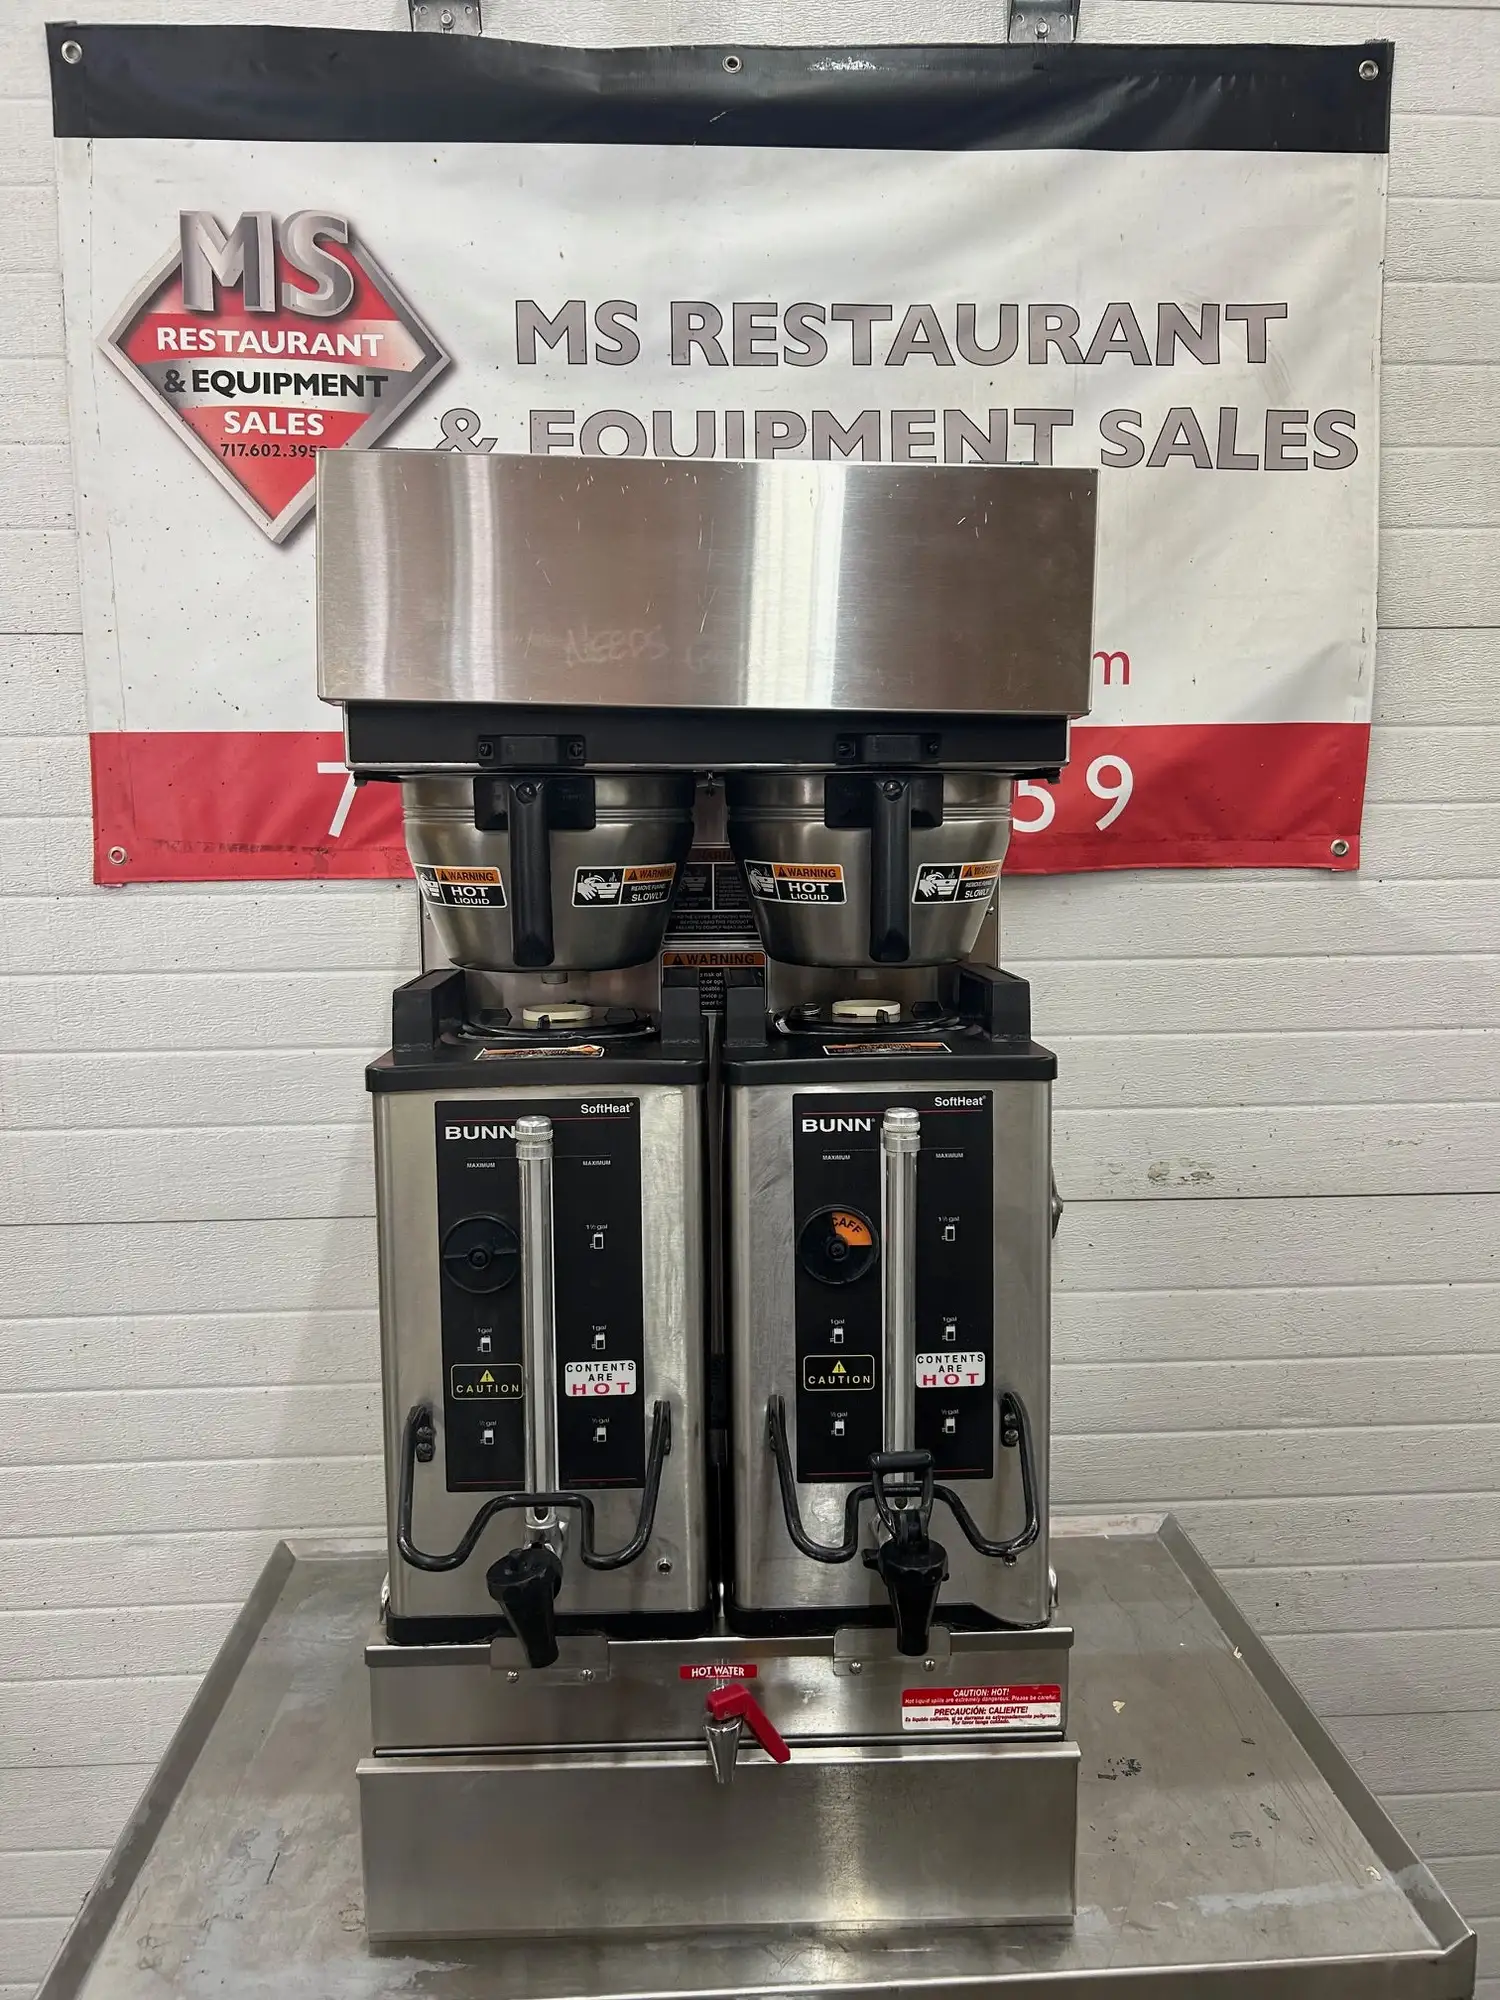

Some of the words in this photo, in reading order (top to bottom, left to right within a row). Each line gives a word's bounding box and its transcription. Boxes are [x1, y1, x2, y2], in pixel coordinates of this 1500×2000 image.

[179, 209, 354, 317] MS
[515, 299, 641, 366] MS
[670, 301, 1288, 367] RESTAURANT
[157, 327, 384, 357] RESTAURANT
[164, 370, 185, 393] &
[192, 369, 388, 398] EQUIPMENT
[224, 411, 324, 436] SALES
[435, 407, 498, 453] &
[529, 408, 1074, 464] EQUIPMENT
[1100, 406, 1359, 472] SALES
[448, 871, 494, 881] WARNING
[787, 868, 836, 878] WARNING
[451, 886, 489, 897] HOT
[788, 882, 829, 893] HOT
[454, 897, 490, 905] LIQUID
[631, 891, 664, 902] SLOWLY
[790, 893, 829, 901] LIQUID
[686, 953, 755, 966] WARNING
[445, 1126, 516, 1140] BUNN
[917, 1354, 984, 1364] CONTENTS
[566, 1362, 634, 1373] CONTENTS
[938, 1364, 963, 1373] ARE
[588, 1373, 613, 1381] ARE
[808, 1375, 871, 1385] CAUTION
[922, 1373, 980, 1386] HOT
[456, 1384, 519, 1393] CAUTION
[572, 1382, 630, 1395] HOT
[692, 1666, 712, 1677] HOT
[714, 1665, 745, 1677] WATER
[953, 1688, 989, 1697] CAUTION:
[991, 1687, 1010, 1697] HOT!
[934, 1705, 987, 1716] PRECAUCIÓN:
[988, 1706, 1029, 1715] CALIENTE!
